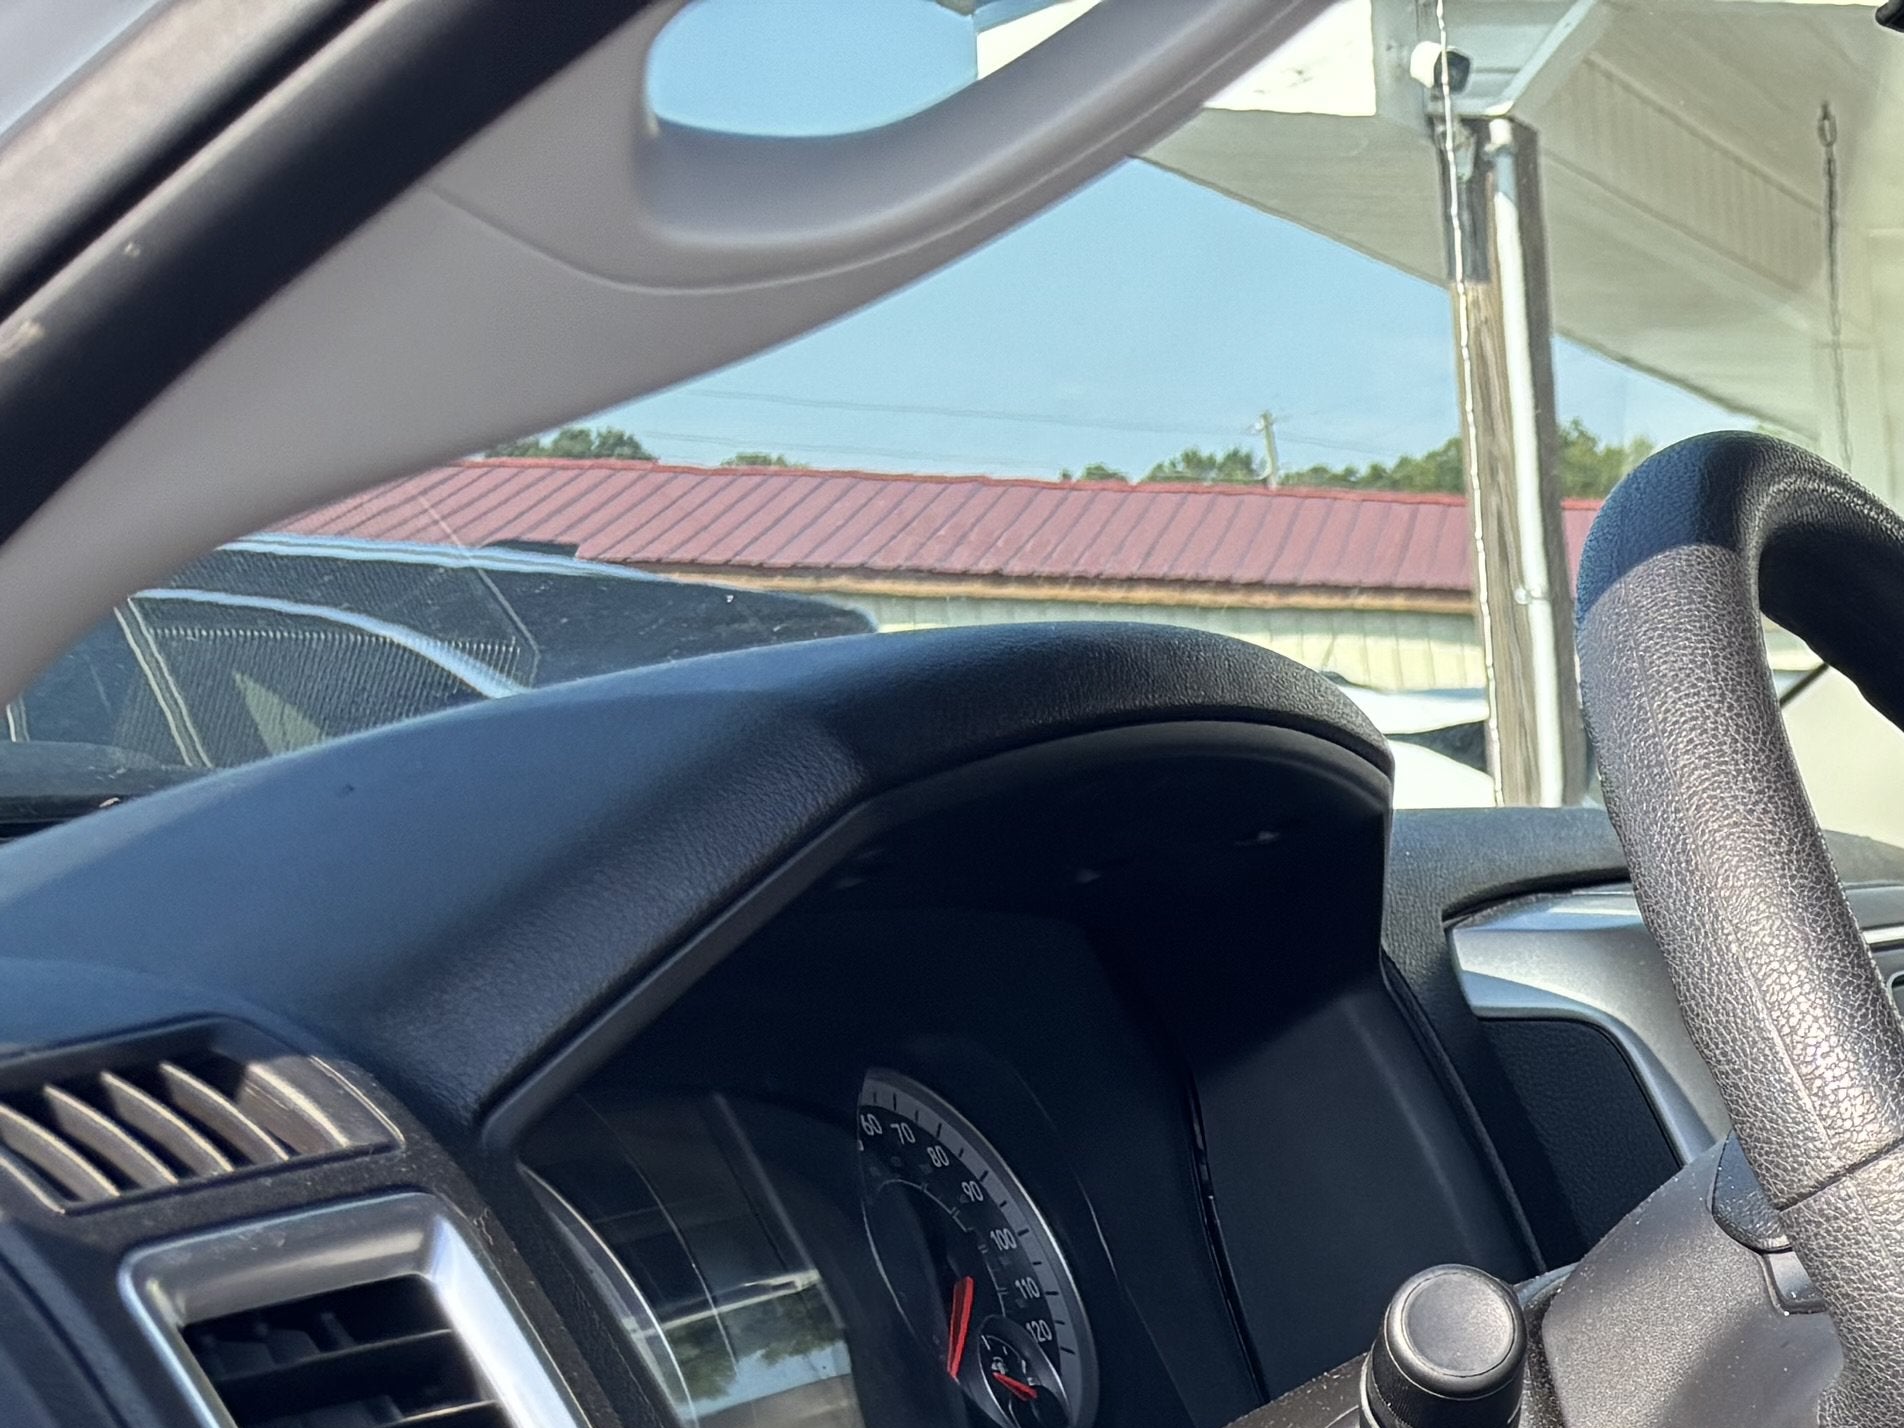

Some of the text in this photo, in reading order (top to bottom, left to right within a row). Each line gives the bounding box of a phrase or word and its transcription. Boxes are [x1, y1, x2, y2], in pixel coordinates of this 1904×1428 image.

[860, 1113, 883, 1136] 60
[890, 1122, 916, 1145] 70
[926, 1145, 950, 1169] 80
[960, 1180, 984, 1202] 90
[989, 1227, 1018, 1252] 100
[1015, 1276, 1041, 1300] 110
[1026, 1319, 1053, 1343] 120
